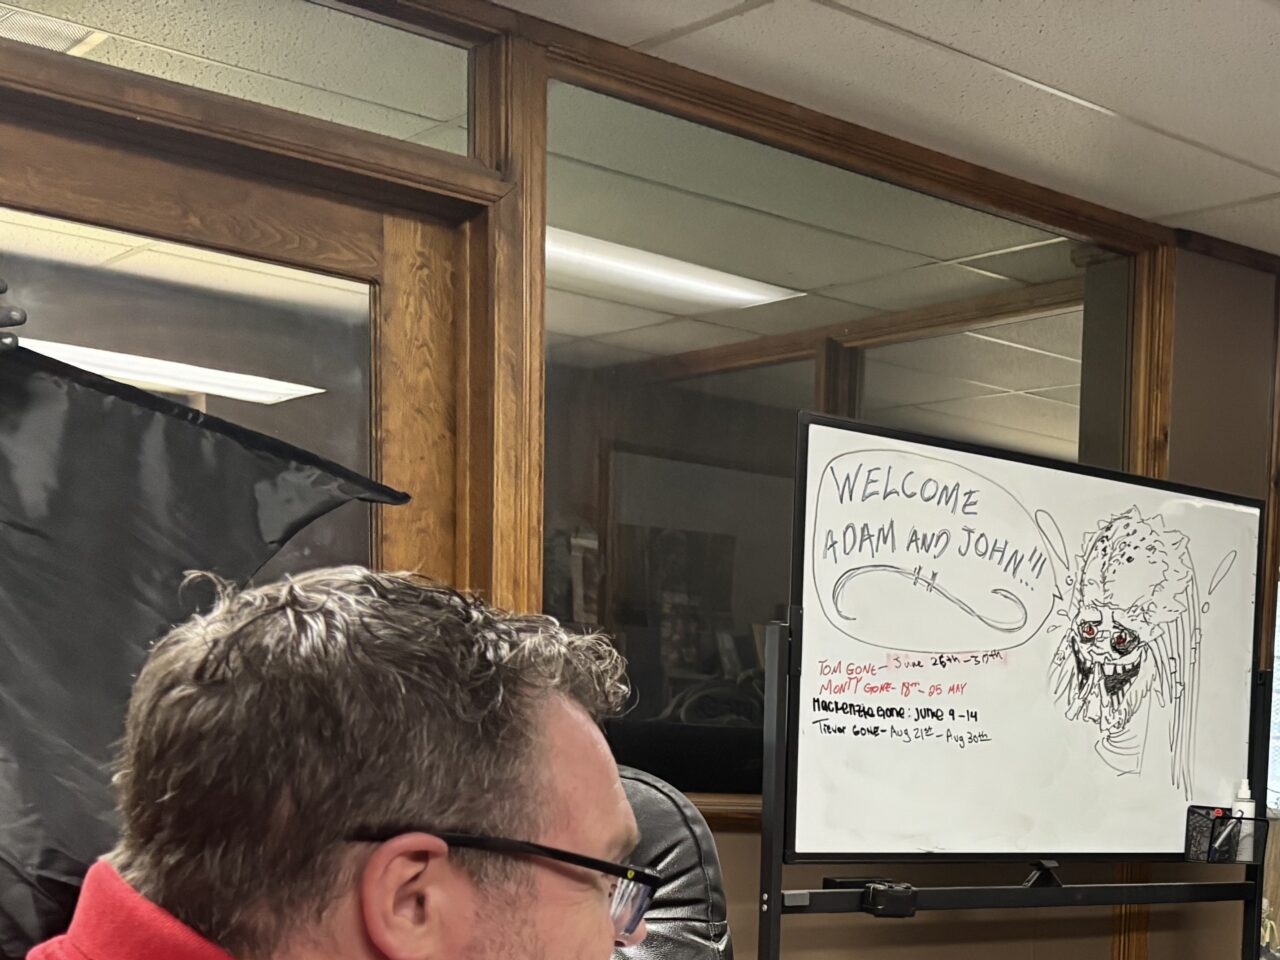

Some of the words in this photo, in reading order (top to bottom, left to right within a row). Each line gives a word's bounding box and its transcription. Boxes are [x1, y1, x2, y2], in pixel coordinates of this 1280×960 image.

[830, 463, 980, 515] WELCOME
[823, 518, 896, 563] ADAM
[906, 526, 951, 559] AND
[958, 526, 1047, 591] JOHN!!!
[818, 660, 842, 676] TOM
[819, 676, 862, 695] MONTY
[928, 684, 943, 697] 25
[948, 681, 967, 695] MAY
[948, 708, 956, 721] 9
[890, 724, 912, 743] Aug
[913, 725, 935, 741] 21st
[946, 728, 966, 749] Aug
[967, 730, 992, 744] 30th
